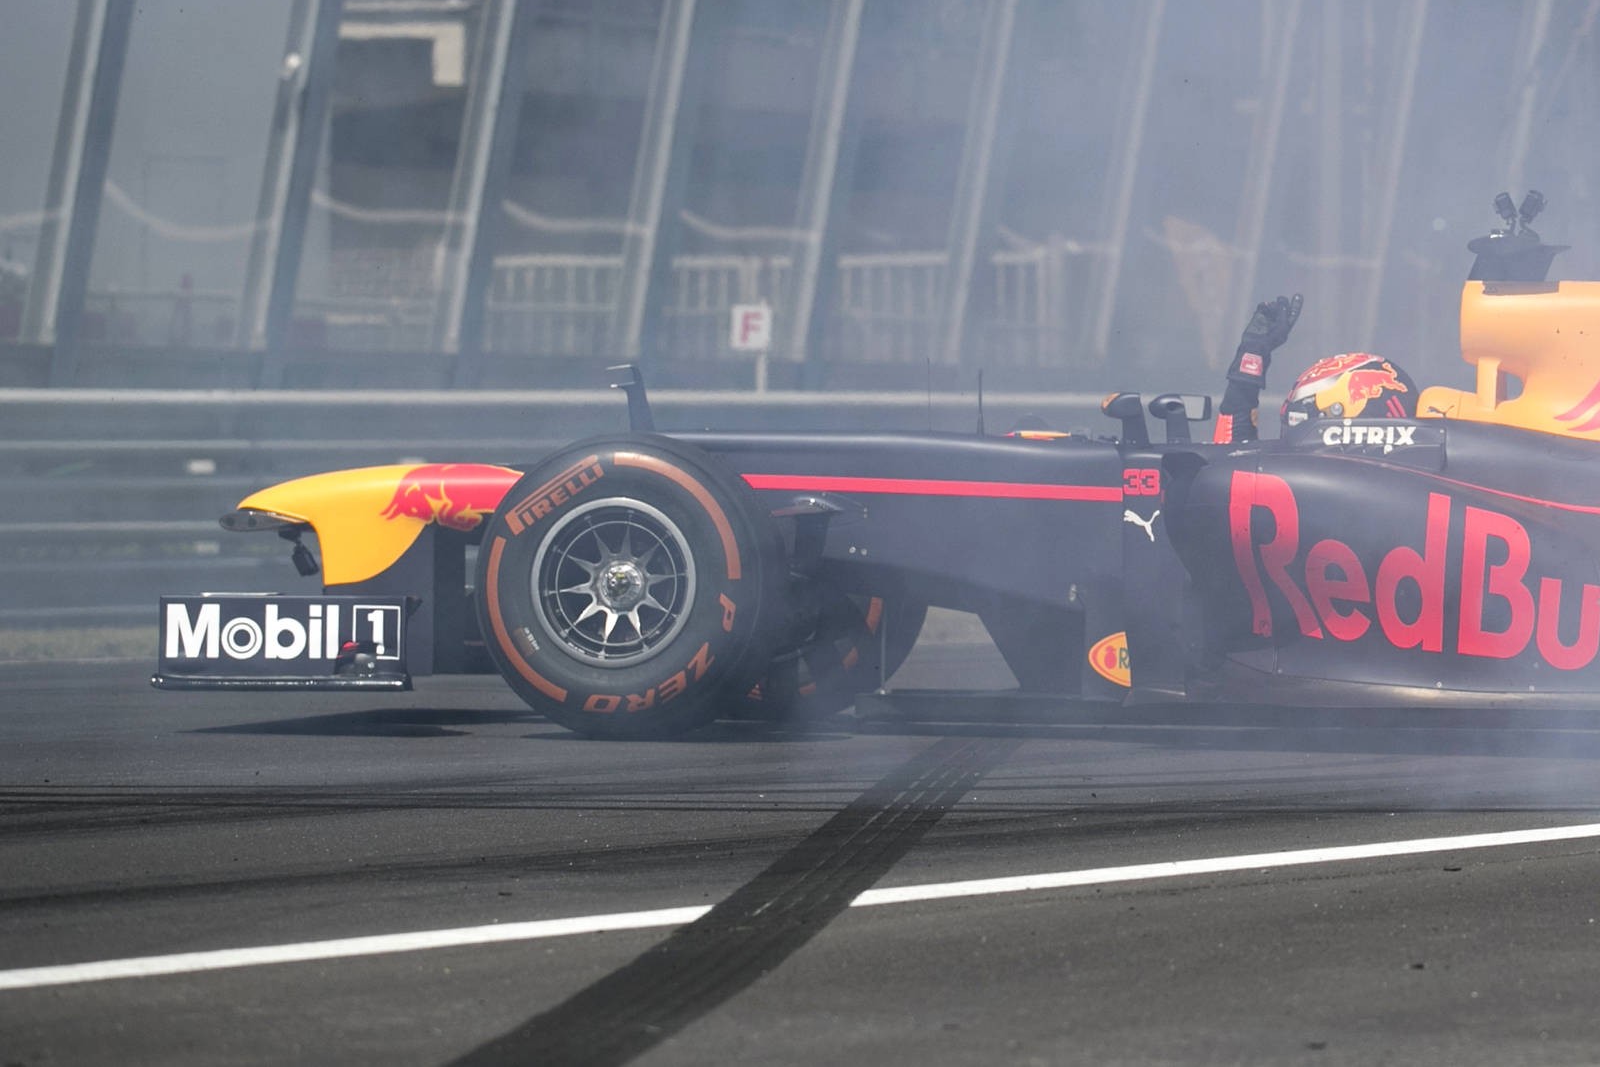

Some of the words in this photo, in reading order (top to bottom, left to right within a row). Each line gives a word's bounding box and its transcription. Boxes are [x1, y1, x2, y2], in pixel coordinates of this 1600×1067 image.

[740, 310, 763, 343] F
[504, 454, 605, 536] PIRELLI
[1123, 468, 1161, 496] 33
[165, 603, 340, 659] Mobil
[367, 609, 385, 655] 1
[583, 642, 715, 713] ZERO
